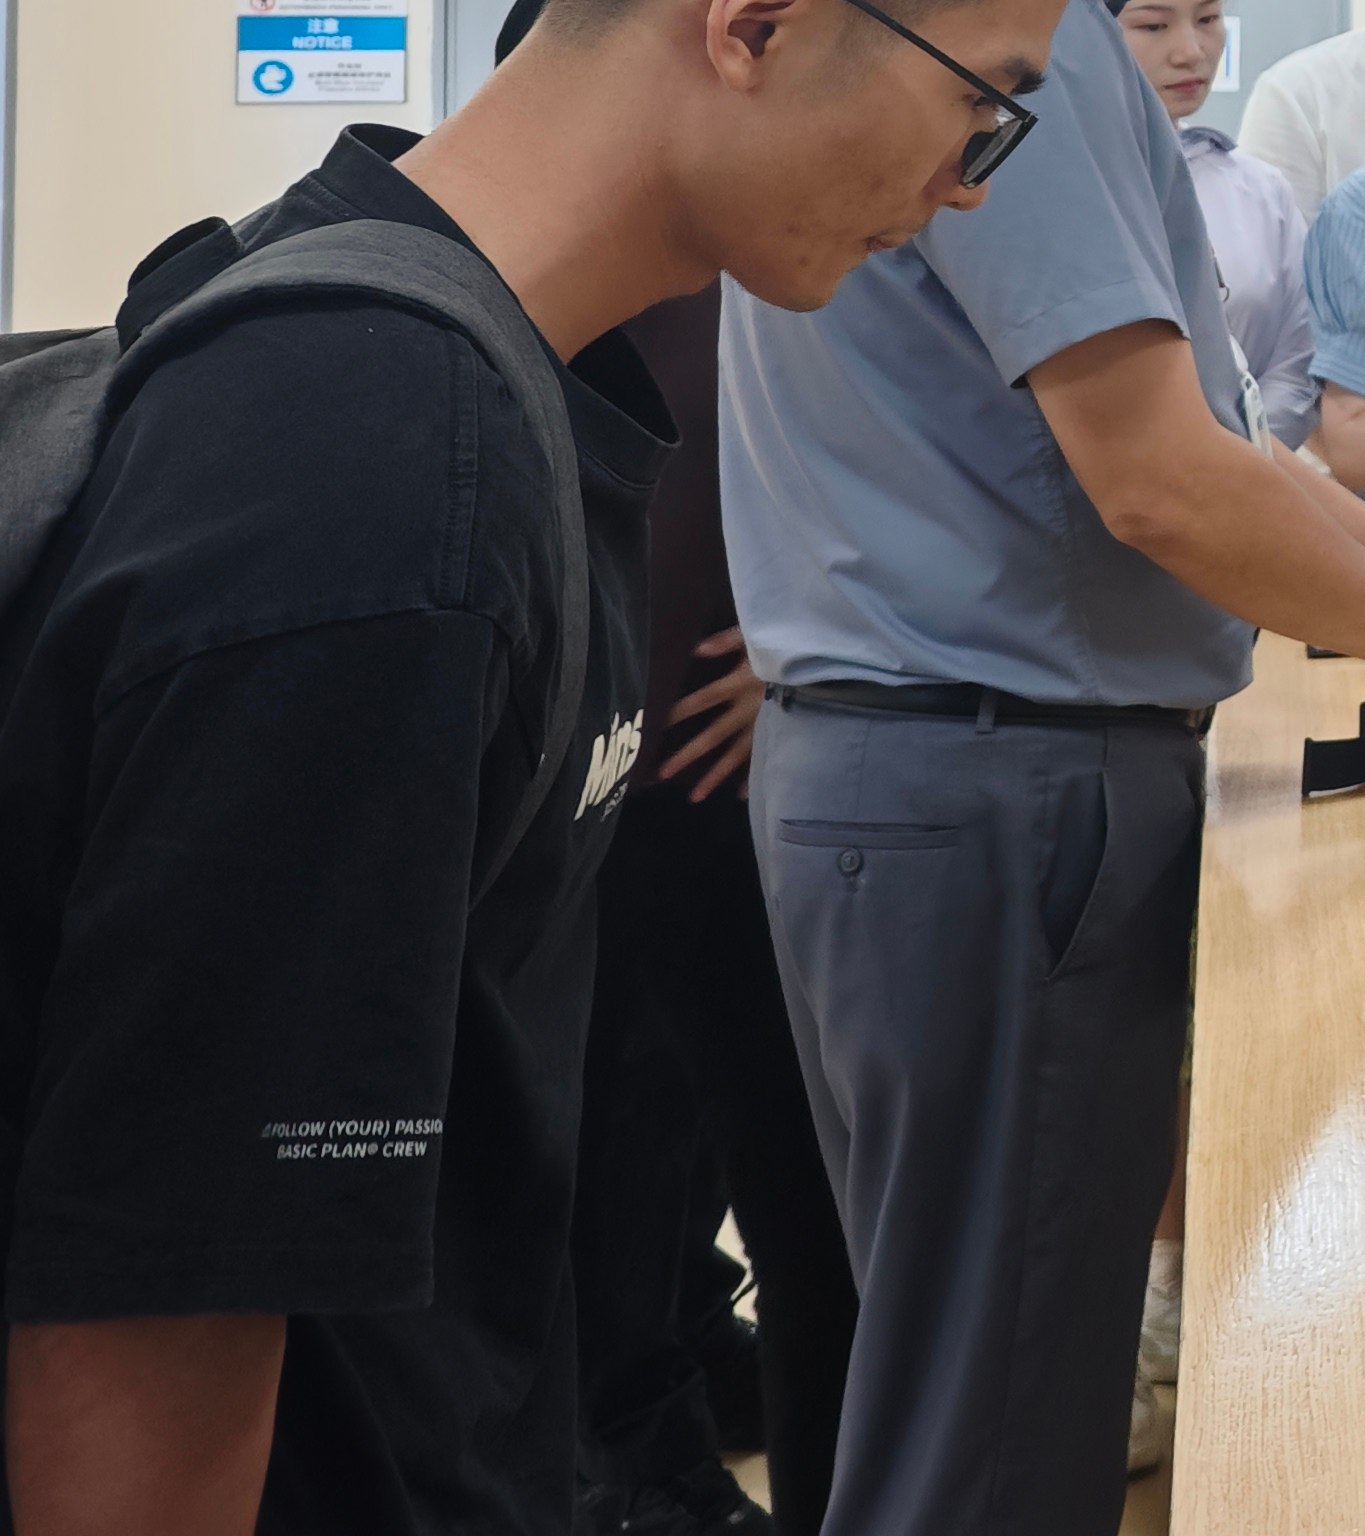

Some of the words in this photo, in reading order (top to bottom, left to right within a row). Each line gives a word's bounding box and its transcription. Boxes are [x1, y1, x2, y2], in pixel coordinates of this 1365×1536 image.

[292, 36, 352, 49] NOTICE
[328, 1120, 391, 1139] (YOUR)
[277, 1143, 318, 1159] BASIC
[382, 1141, 428, 1158] CREW
